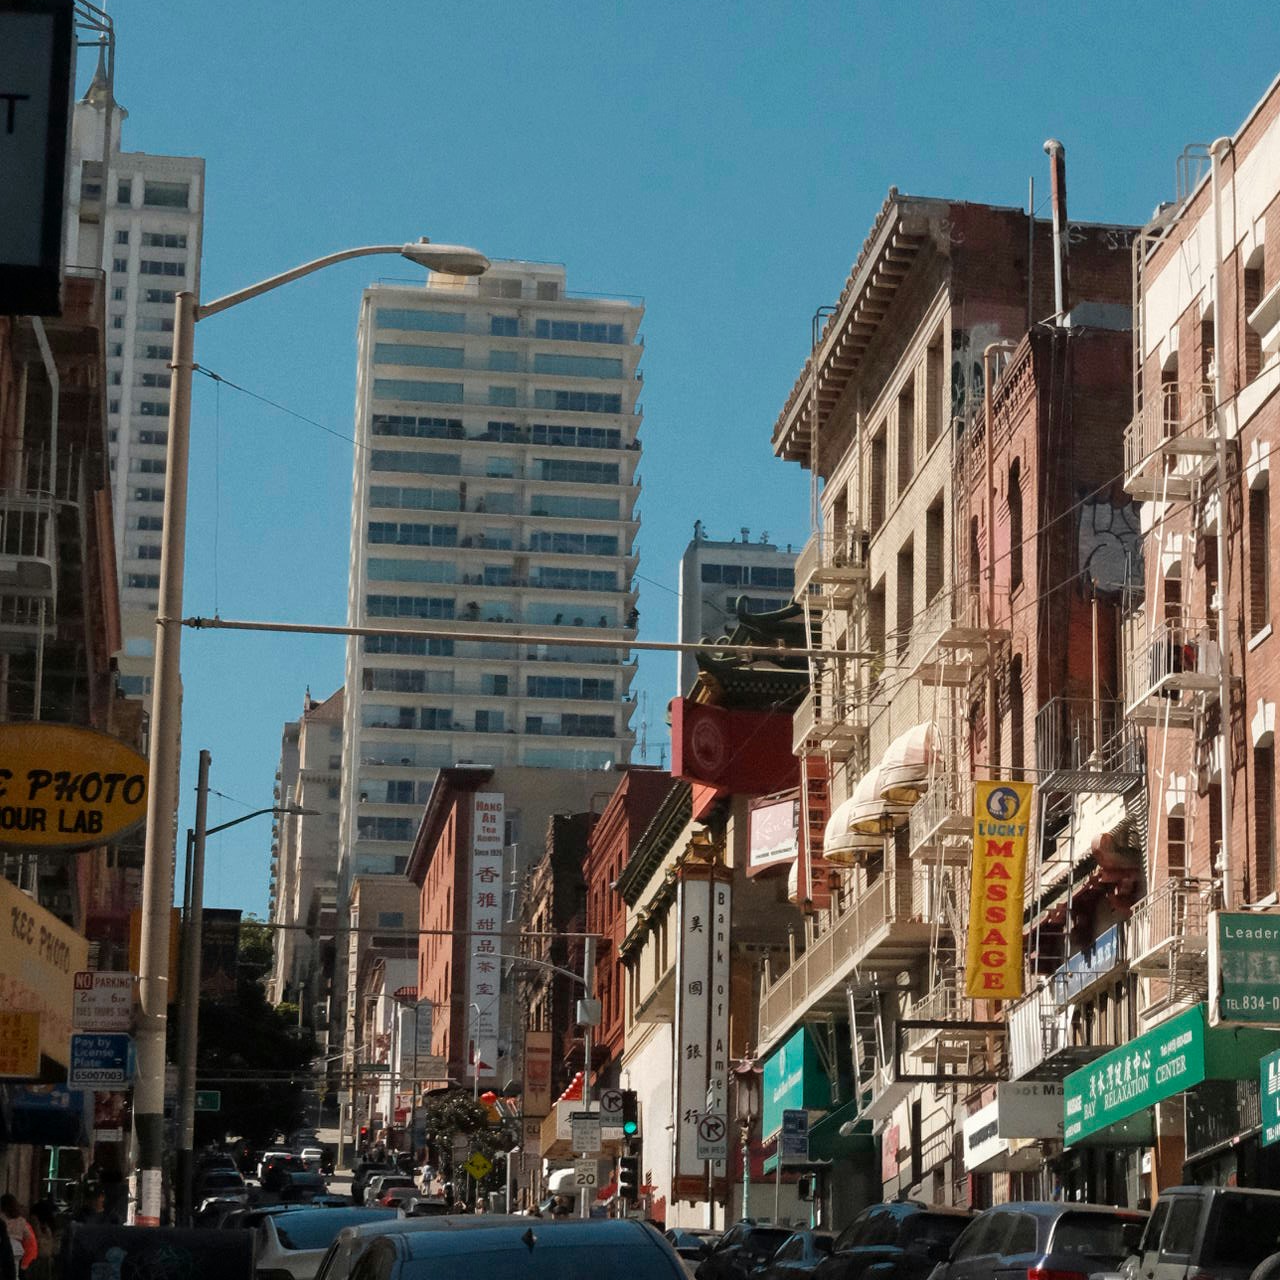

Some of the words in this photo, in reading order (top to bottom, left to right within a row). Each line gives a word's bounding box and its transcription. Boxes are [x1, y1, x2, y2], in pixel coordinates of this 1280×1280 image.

[27, 768, 146, 805] PHOTO
[0, 806, 47, 832] OUR
[58, 809, 103, 834] LAB
[978, 823, 1026, 837] LUCKY
[11, 906, 35, 945] KEE
[716, 891, 724, 964] Bank
[980, 839, 1015, 990] MASSAGE
[1225, 926, 1279, 939] Leader
[75, 973, 92, 988] NO
[95, 977, 130, 987] PARKING
[715, 984, 723, 1017] of
[684, 916, 703, 1126] 美國銀行
[75, 1038, 94, 1049] Pay
[97, 1037, 112, 1048] by
[75, 1047, 114, 1057] License
[75, 1071, 122, 1080] 65007003
[1083, 1100, 1096, 1120] BAY
[1104, 1073, 1149, 1110] RELAXATION
[1155, 1054, 1186, 1084] CENTER
[577, 1173, 595, 1185] 20
